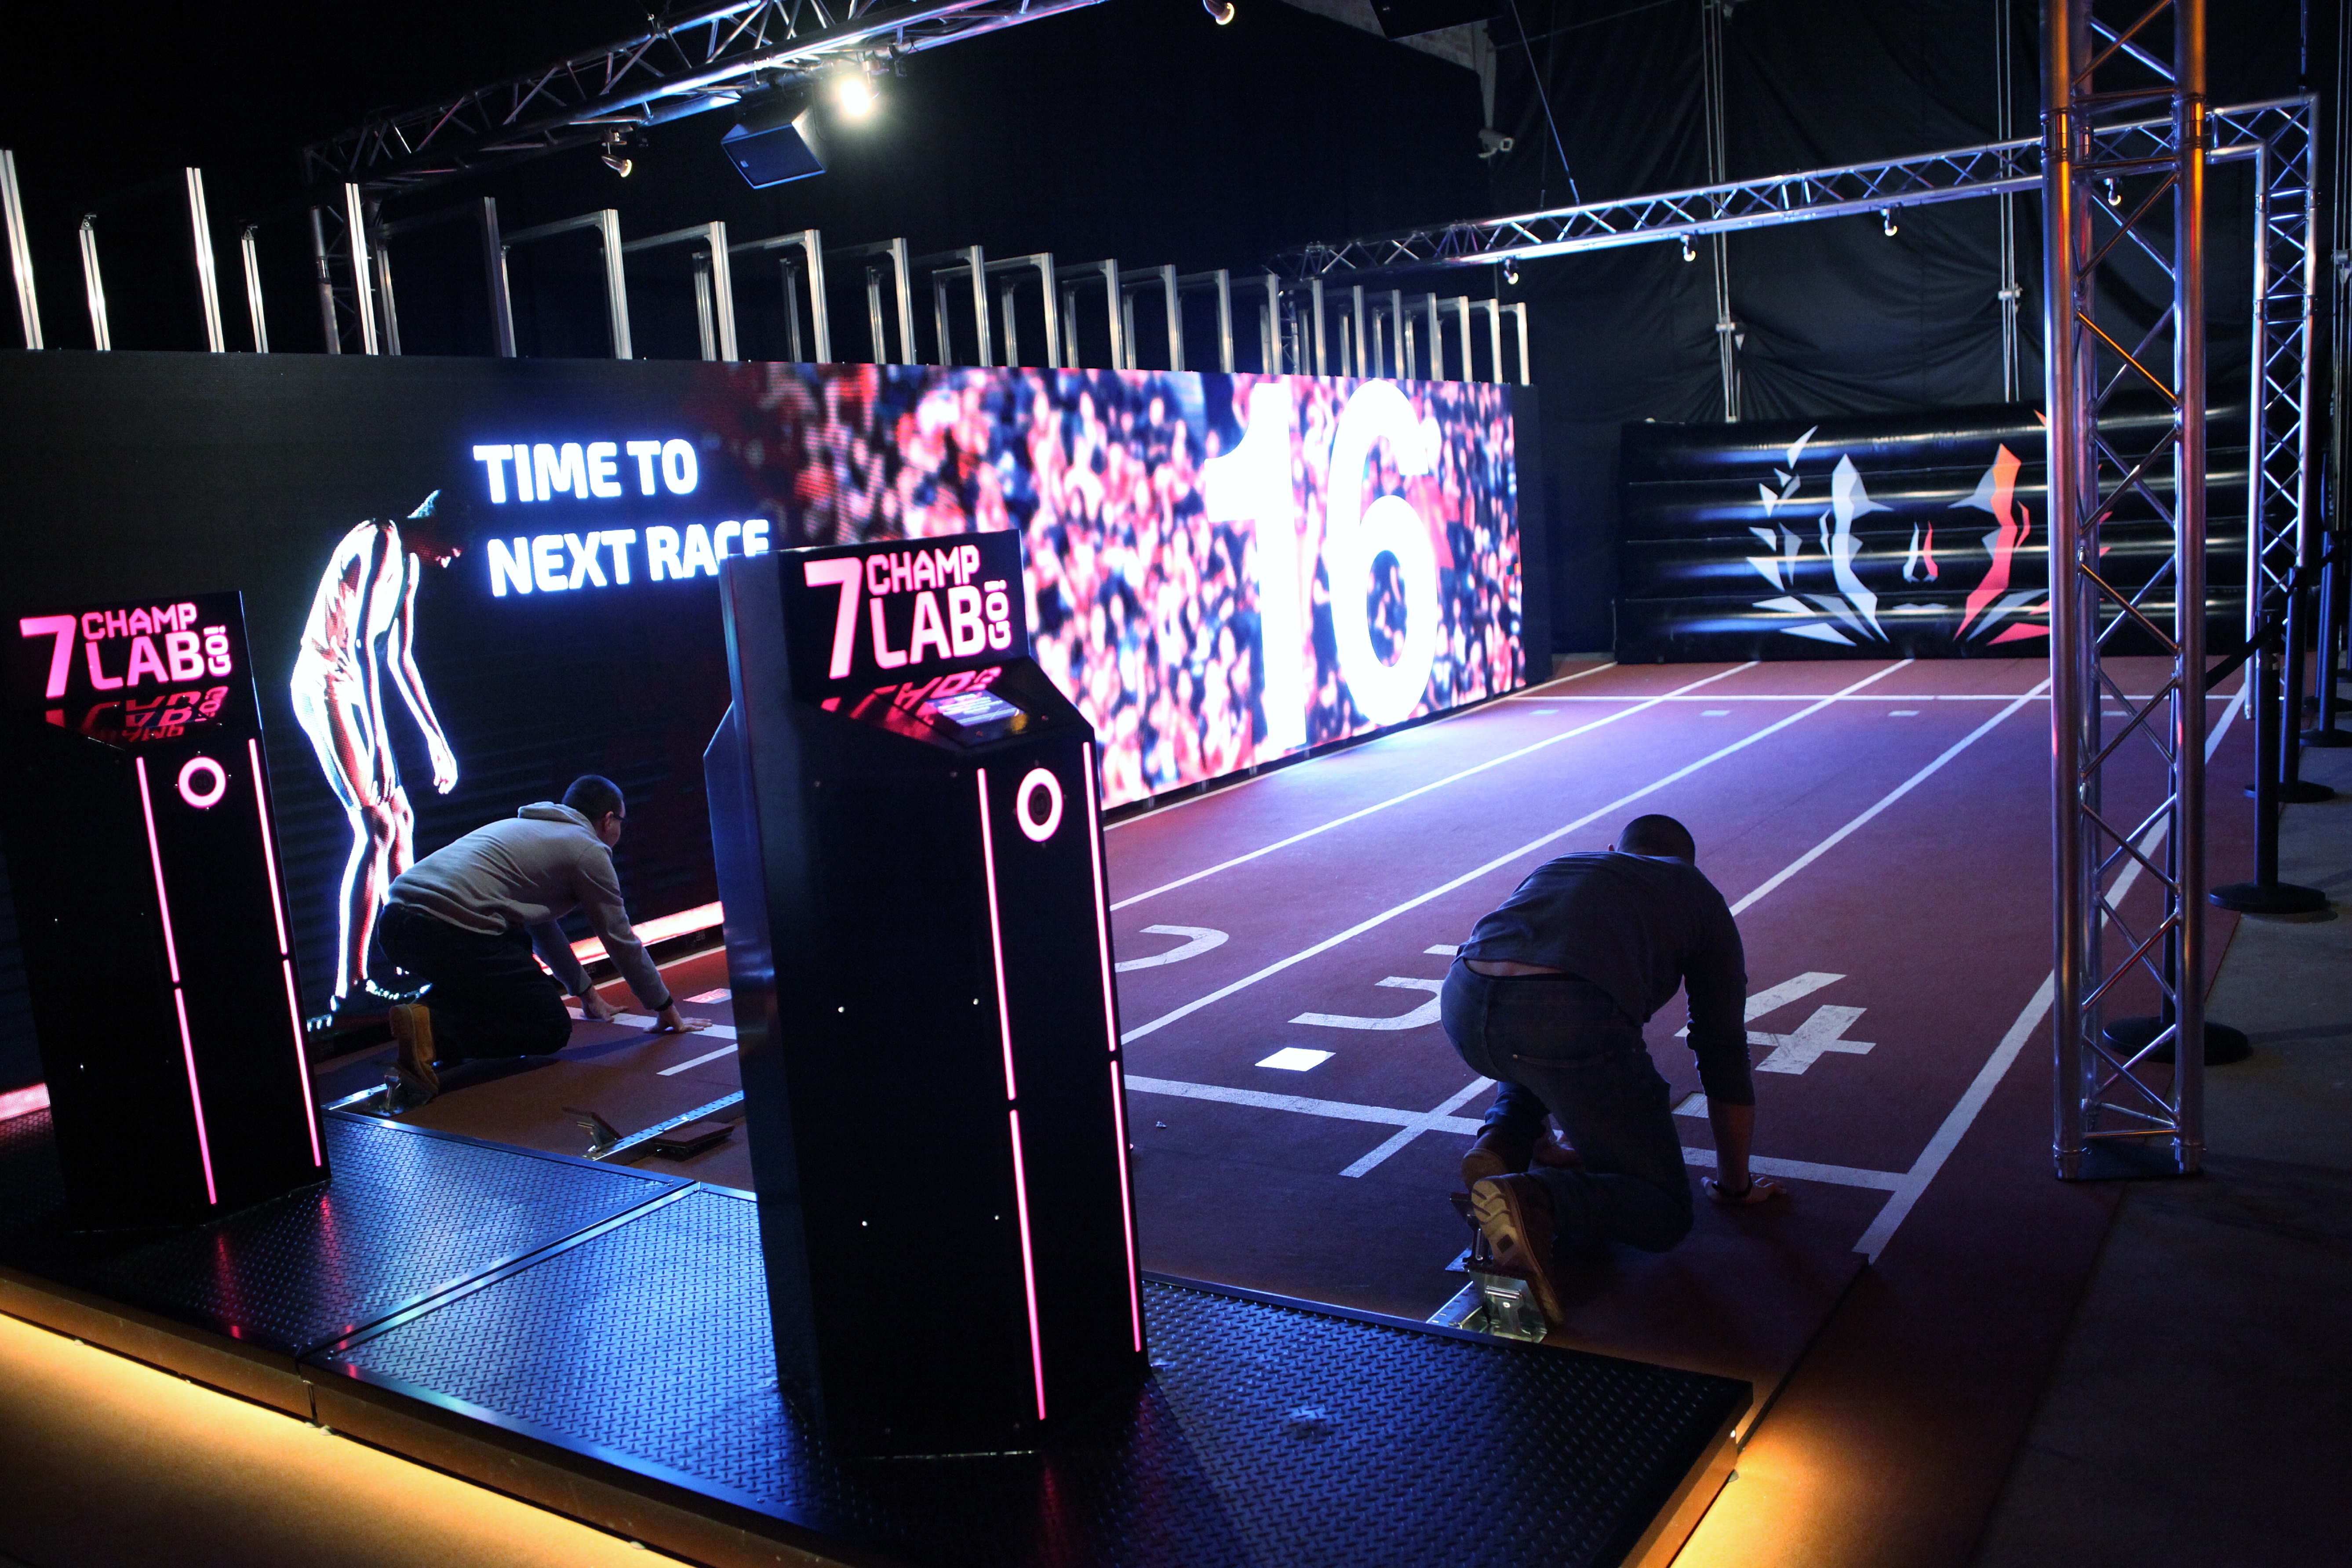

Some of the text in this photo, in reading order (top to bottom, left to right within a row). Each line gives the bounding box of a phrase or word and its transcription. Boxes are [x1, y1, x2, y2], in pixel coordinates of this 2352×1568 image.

[473, 439, 698, 504] TIME TO
[487, 519, 769, 597] NEXT RACE
[866, 544, 980, 596] CHAMP
[1204, 380, 1438, 746] 16
[81, 602, 198, 640] CHAMP
[203, 625, 232, 677] GO!
[804, 557, 863, 680] 7
[869, 585, 986, 669] LAB
[984, 579, 1012, 650] GO!
[19, 615, 77, 699] 7
[85, 630, 205, 691] LAB
[1674, 971, 1877, 1075] 4
